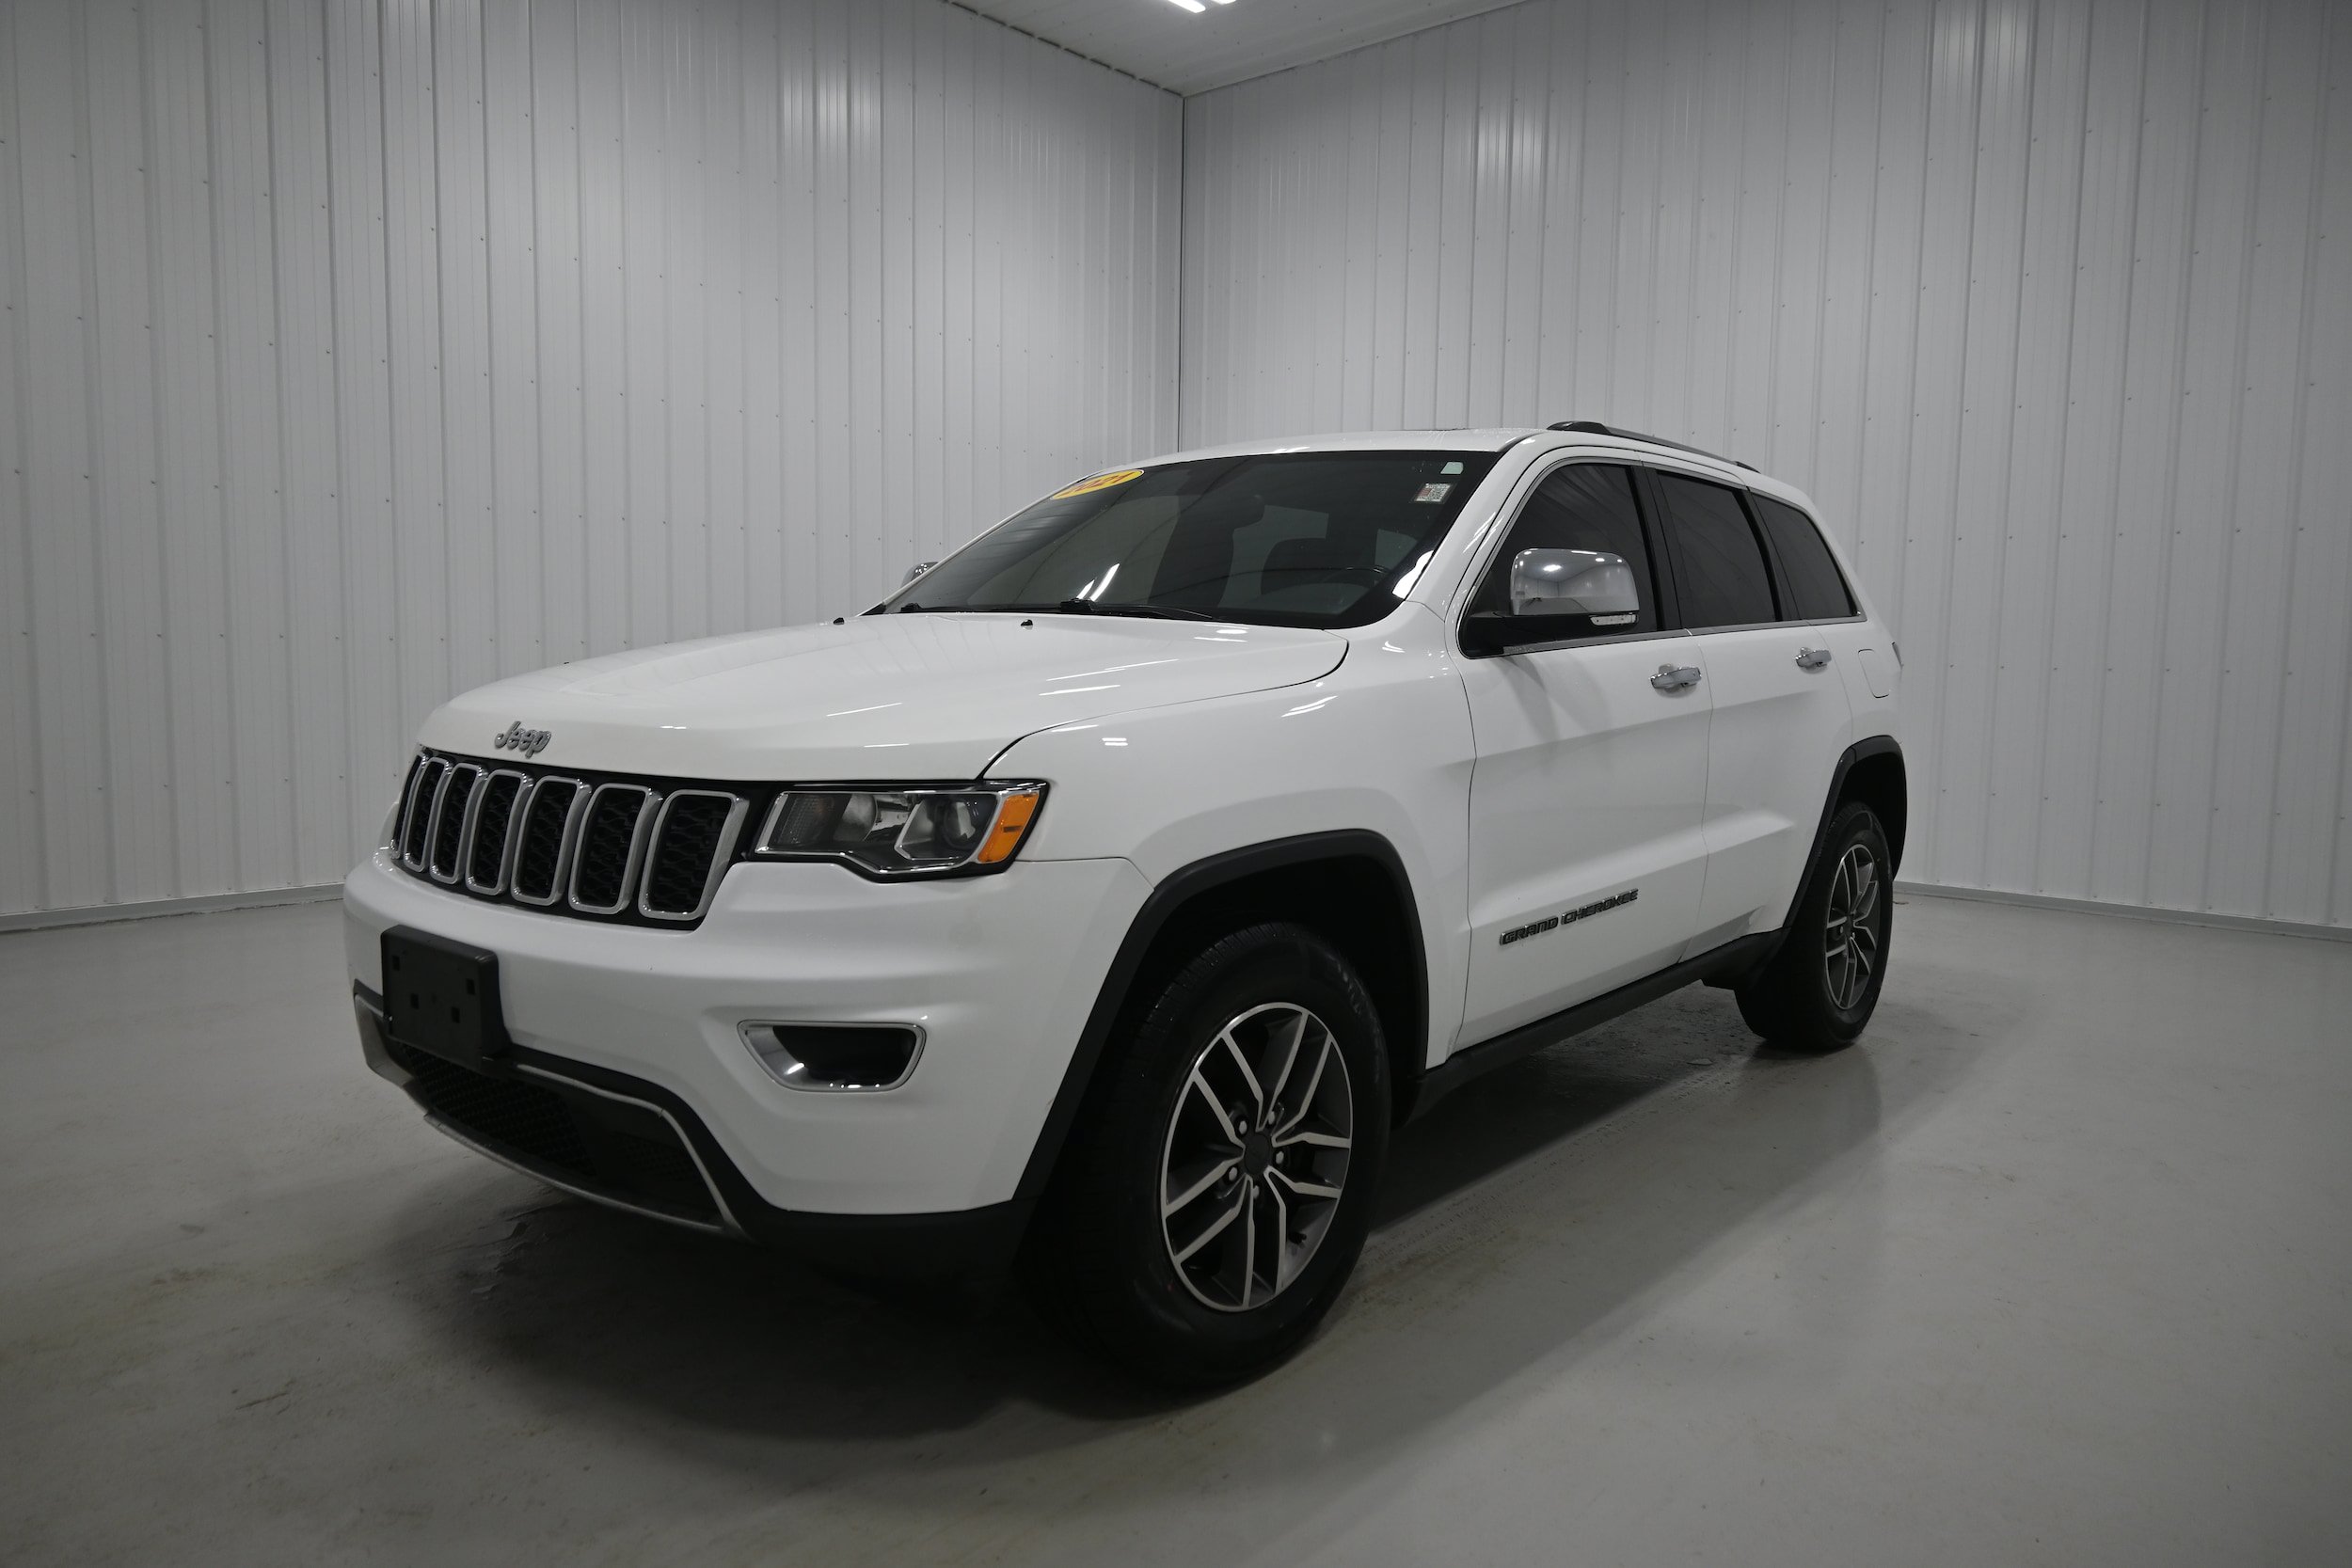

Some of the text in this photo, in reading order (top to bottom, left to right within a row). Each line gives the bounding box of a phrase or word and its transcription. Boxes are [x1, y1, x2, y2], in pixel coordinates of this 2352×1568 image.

[495, 721, 552, 759] Jeep
[1499, 888, 1639, 945] GRAND CHEROKEE
